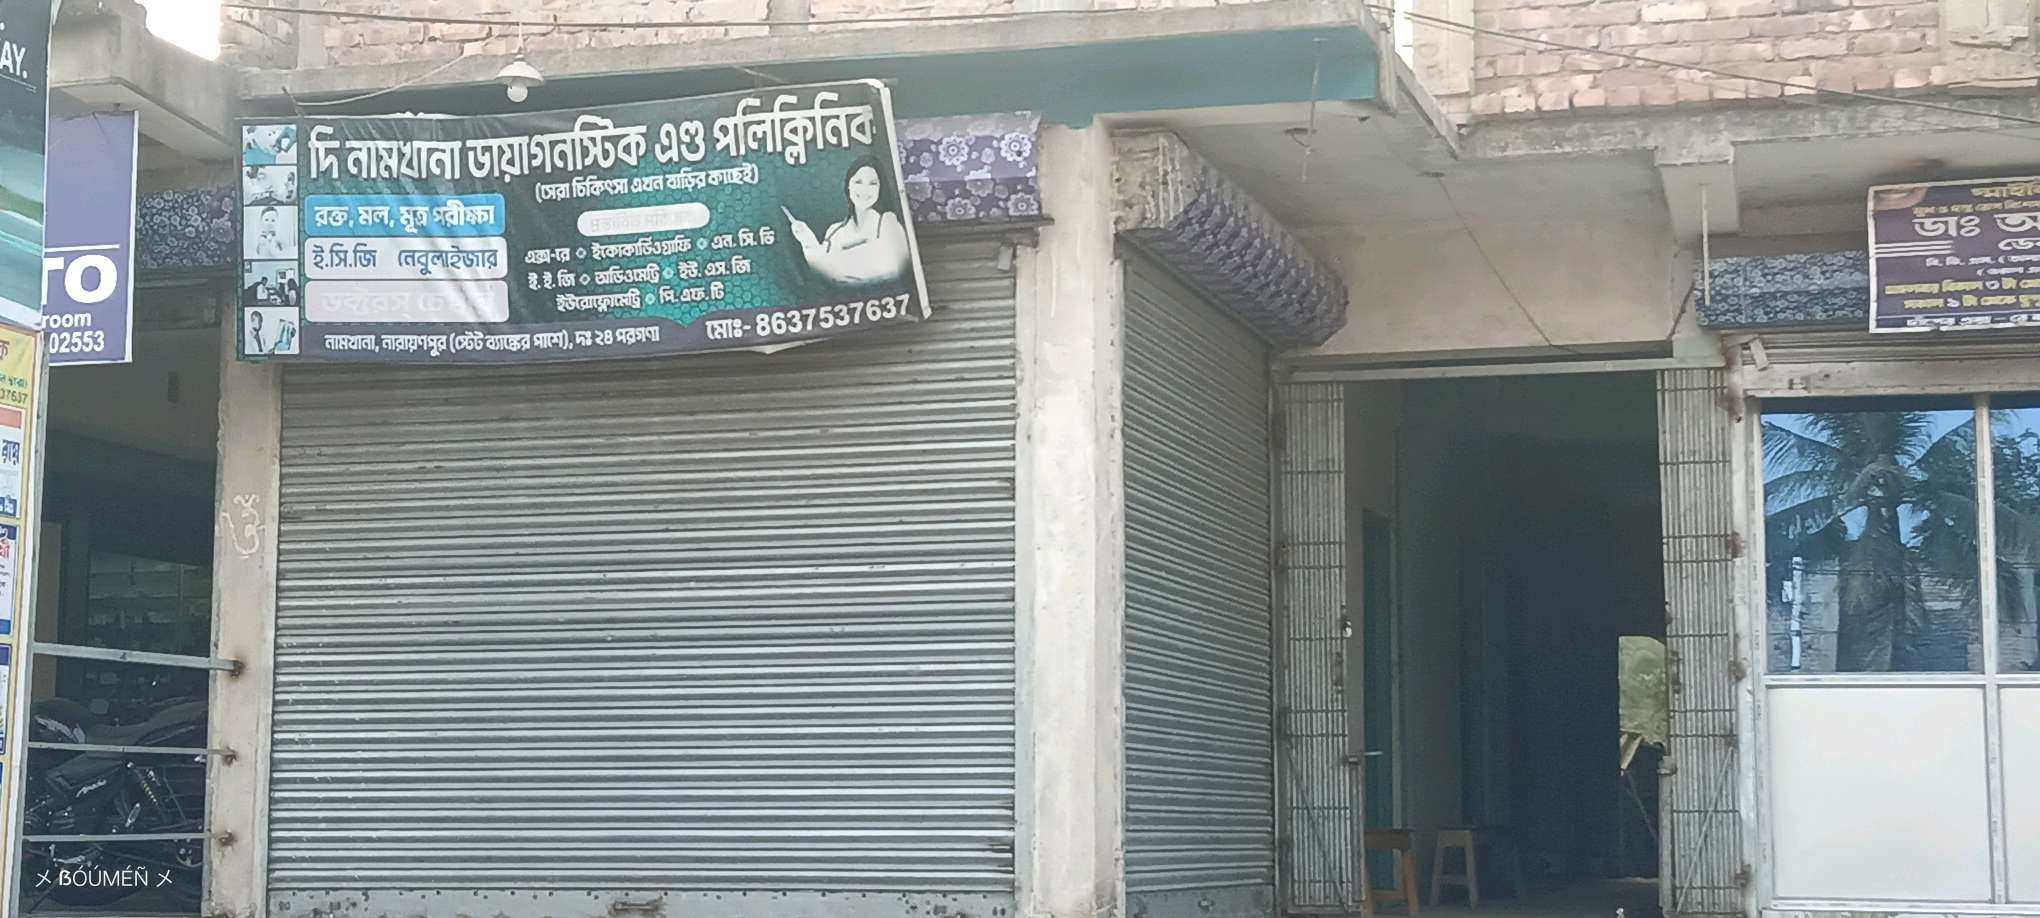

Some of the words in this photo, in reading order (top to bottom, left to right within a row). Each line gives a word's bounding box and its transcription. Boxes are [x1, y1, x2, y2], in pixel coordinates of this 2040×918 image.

[308, 125, 341, 180] দি
[345, 140, 462, 180] নামখানা
[465, 114, 647, 183] ডায়াগনস্টিক
[536, 182, 570, 203] (সেরা
[631, 175, 664, 194] এখন
[666, 166, 706, 192] বাড়ির
[313, 206, 354, 228] রক্ত,
[358, 206, 395, 228] মল,
[400, 206, 430, 234] মূত্র
[433, 199, 496, 226] পরীক্ষা
[1912, 215, 1980, 237] ডাঃ
[398, 244, 499, 276] নেবুলাইজার
[755, 293, 910, 337] 8637537637
[49, 330, 105, 353] 02553
[324, 335, 379, 353] নামখানা,
[382, 335, 447, 357] নারায়ণপুর
[594, 330, 613, 345] ২৪
[615, 326, 660, 344] পরগণা
